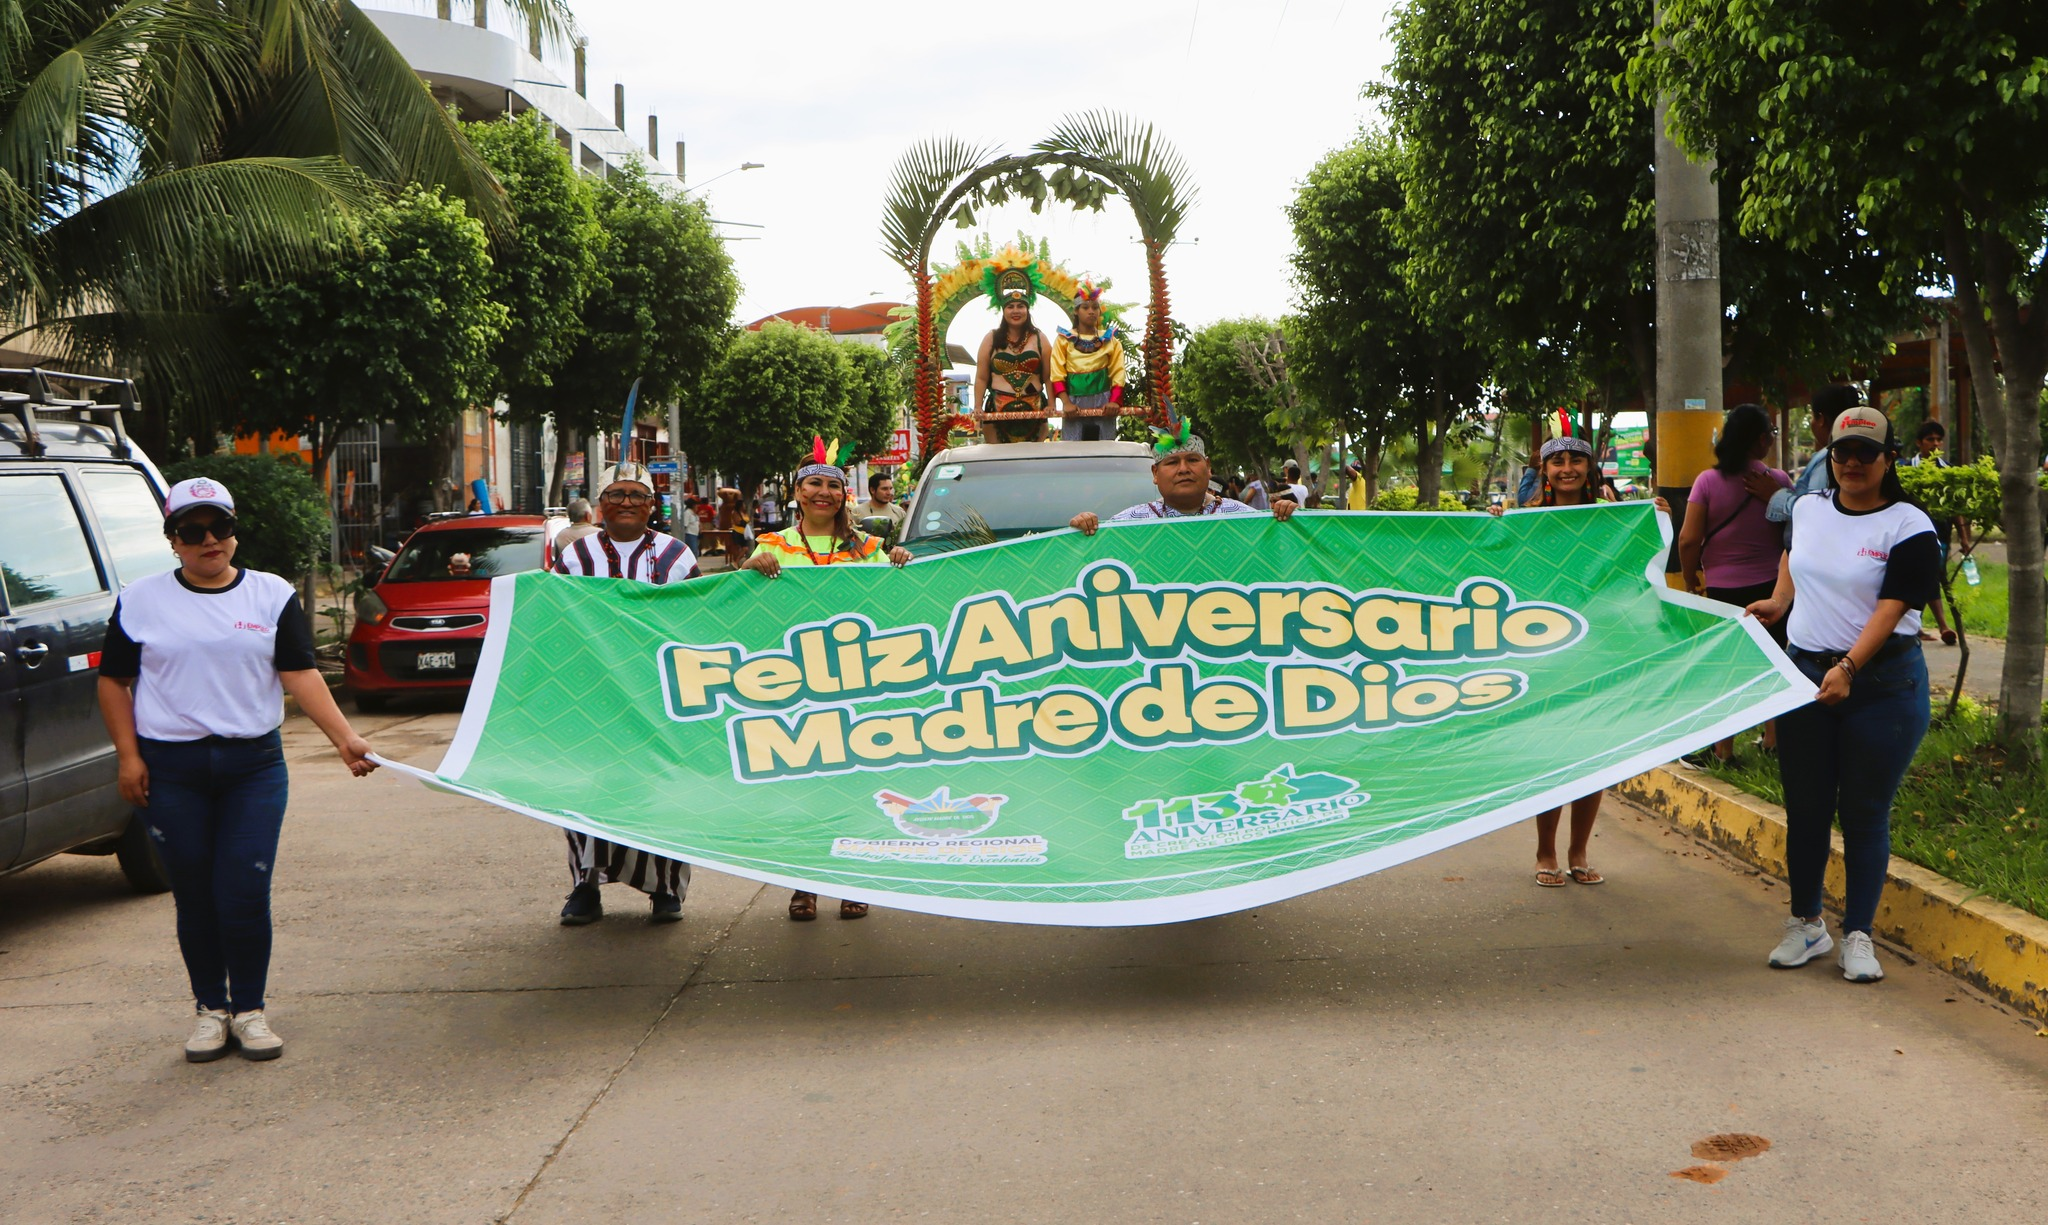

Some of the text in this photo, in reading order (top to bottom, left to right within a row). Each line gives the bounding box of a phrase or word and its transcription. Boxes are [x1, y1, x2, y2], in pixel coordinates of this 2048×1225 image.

[672, 568, 1573, 708] Feliz Aniversario
[741, 663, 1513, 773] Madre de Dios
[1127, 793, 1242, 829] 113
[1132, 793, 1366, 844] ANIVERSARIO
[945, 837, 1043, 847] REGIONAL
[1130, 832, 1264, 857] MADRE DE DIOS
[1130, 842, 1152, 850] DE
[969, 854, 1041, 864] Excelencia
